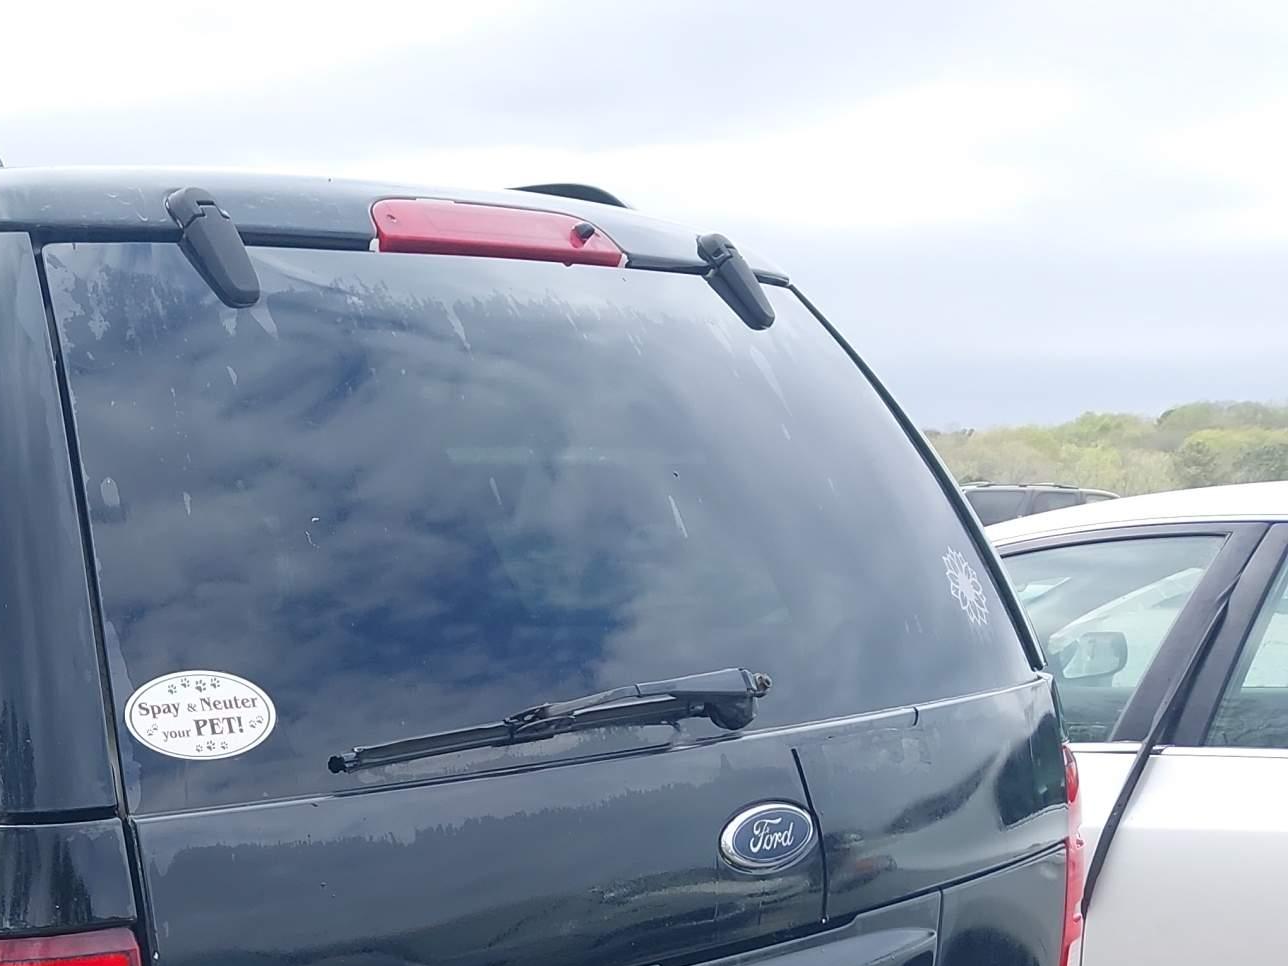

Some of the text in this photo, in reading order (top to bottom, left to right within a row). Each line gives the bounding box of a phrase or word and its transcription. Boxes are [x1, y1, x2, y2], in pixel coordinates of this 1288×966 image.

[137, 695, 258, 719] Spay & Neuter
[162, 716, 245, 742] your PET!
[749, 817, 794, 853] Ford
